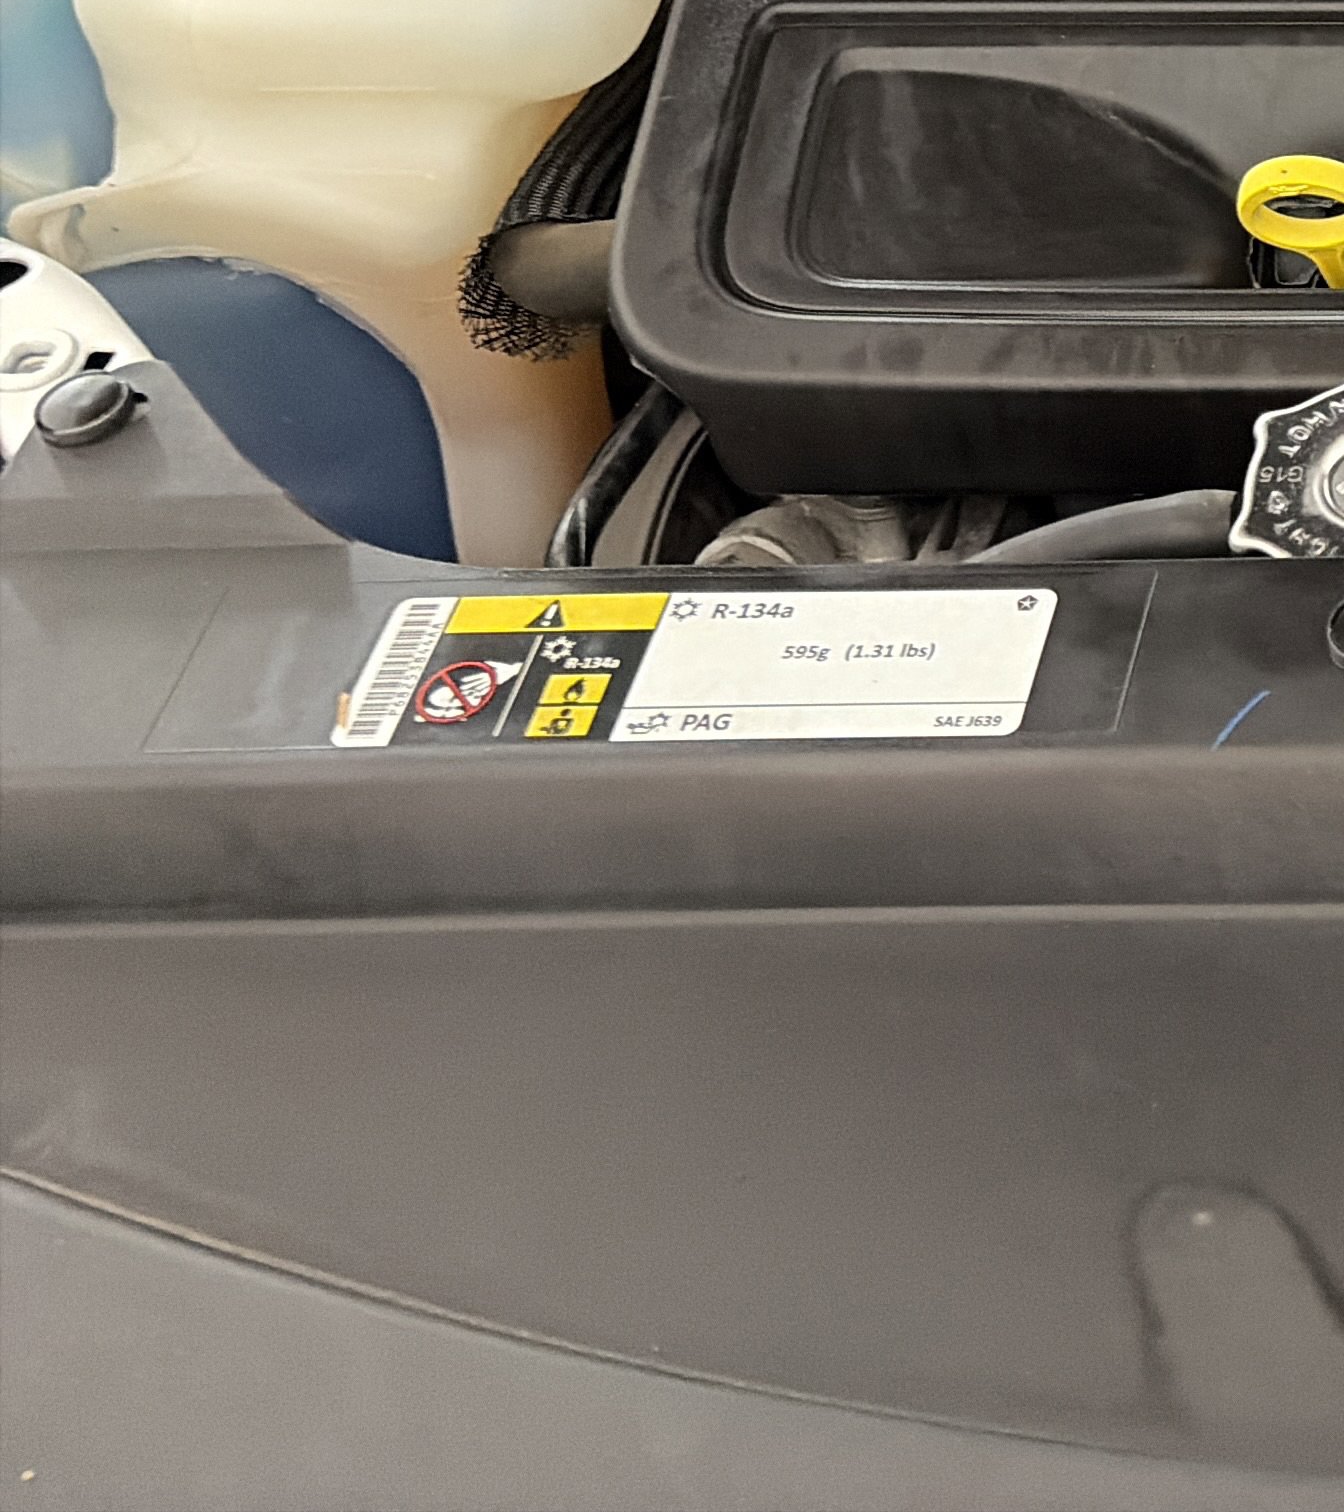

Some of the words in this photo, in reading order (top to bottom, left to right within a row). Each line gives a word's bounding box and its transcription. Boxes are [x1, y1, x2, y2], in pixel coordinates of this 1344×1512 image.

[1277, 410, 1325, 458] HOT
[1258, 465, 1304, 483] G15
[710, 600, 794, 621] R-134a
[780, 643, 831, 664] 595g
[844, 641, 895, 662] (1.31
[899, 640, 937, 662] lbs)
[564, 657, 621, 670] R-134a
[680, 711, 733, 733] PAG
[933, 715, 964, 728] SAE
[966, 714, 1003, 728] J639
